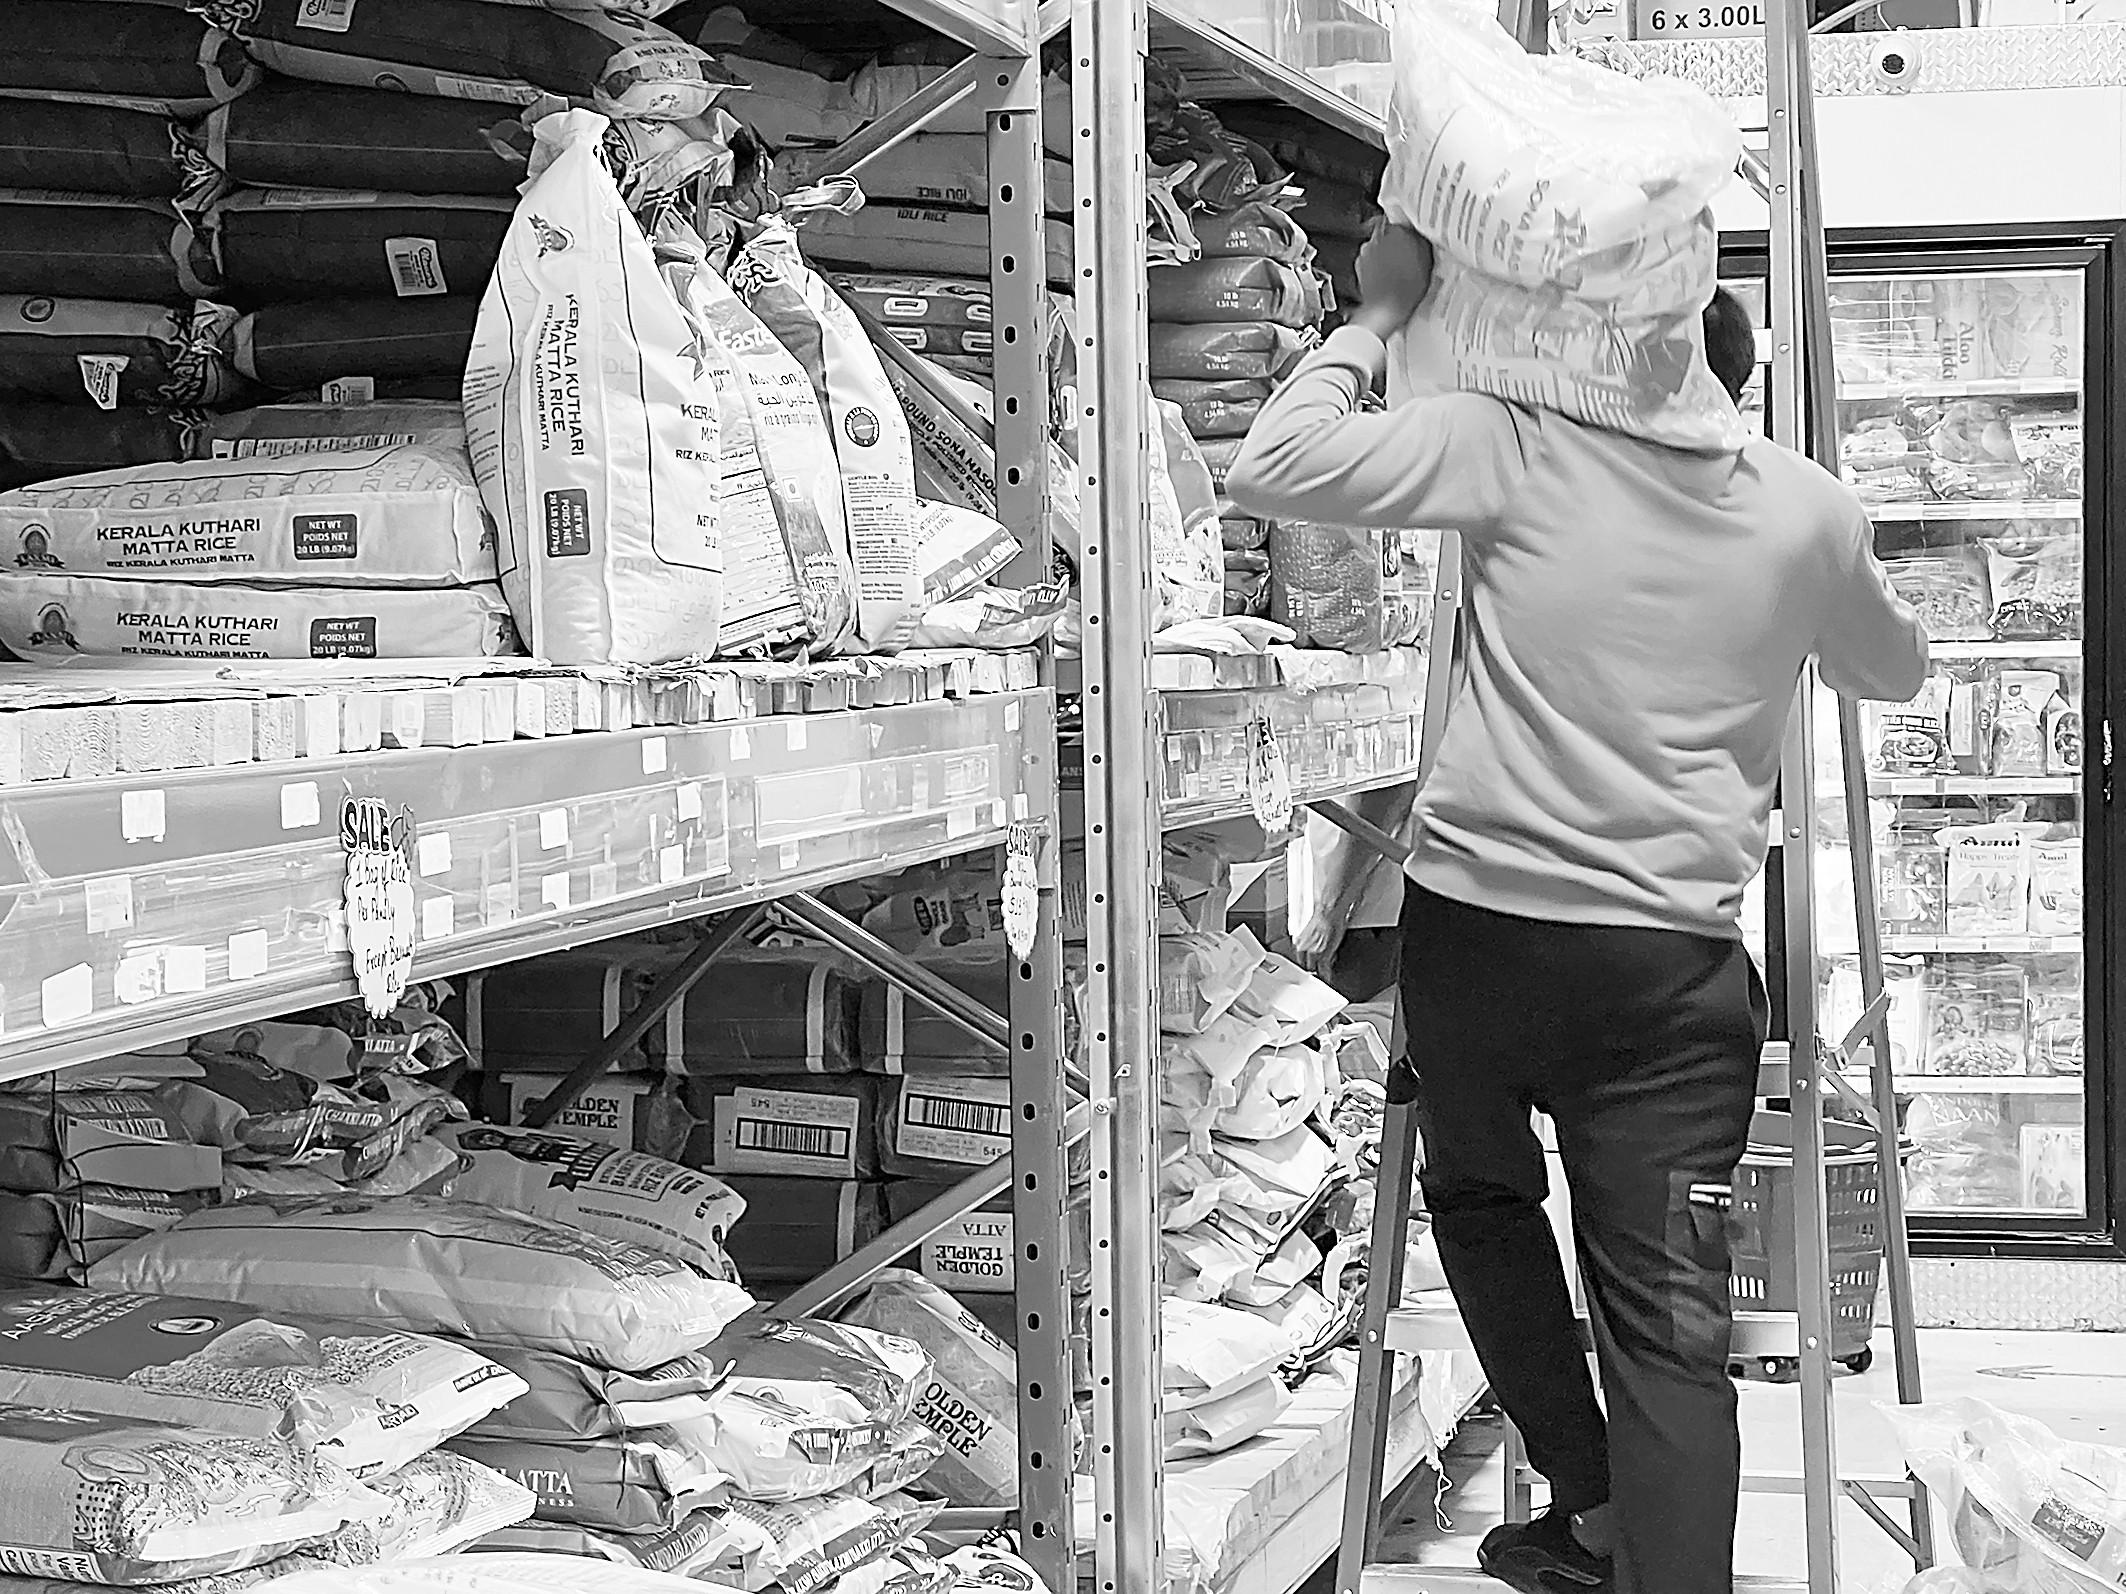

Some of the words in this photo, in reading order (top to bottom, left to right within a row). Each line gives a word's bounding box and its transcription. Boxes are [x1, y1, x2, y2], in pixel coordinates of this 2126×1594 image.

[1652, 10, 1666, 30] 6
[1674, 13, 1689, 29] x
[1698, 5, 1766, 28] 3.00L
[897, 209, 919, 219] IDLI
[922, 210, 949, 222] RICE
[564, 293, 579, 367] KERALA
[547, 319, 565, 382] MATTA
[550, 389, 565, 433] RICE
[565, 372, 584, 456] KUTHARI
[539, 414, 549, 450] MATTA
[900, 396, 936, 434] POUND
[936, 427, 966, 460] SONA
[675, 449, 692, 460] RIZ
[97, 525, 175, 541] KERALA
[179, 518, 261, 536] KUTHARI
[309, 520, 326, 530] NET
[326, 520, 342, 530] WT
[123, 540, 188, 556] MATTA
[194, 536, 236, 551] RICE
[303, 533, 330, 542] POIDS
[331, 532, 349, 541] NET
[309, 545, 320, 554] LB
[126, 558, 168, 568] KERALA
[170, 556, 217, 566] KUTHARI
[219, 553, 255, 563] MATTA
[117, 612, 189, 629] KERALA
[195, 615, 278, 630] KUTHARI
[326, 622, 343, 630] NET
[344, 621, 360, 630] WT
[139, 631, 203, 647] MATTA
[209, 632, 251, 647] RICE
[319, 634, 347, 642] POIDS
[348, 633, 366, 642] NET
[342, 799, 390, 851] SALE
[570, 1097, 619, 1113] LDEN
[555, 1110, 618, 1129] EMPLE
[962, 1223, 1006, 1236] ATTA
[935, 1245, 1003, 1261] TEMPLE
[936, 1260, 1003, 1276] GOLDEN
[925, 1382, 992, 1441] OLDEN
[912, 1397, 978, 1459] EMPLE
